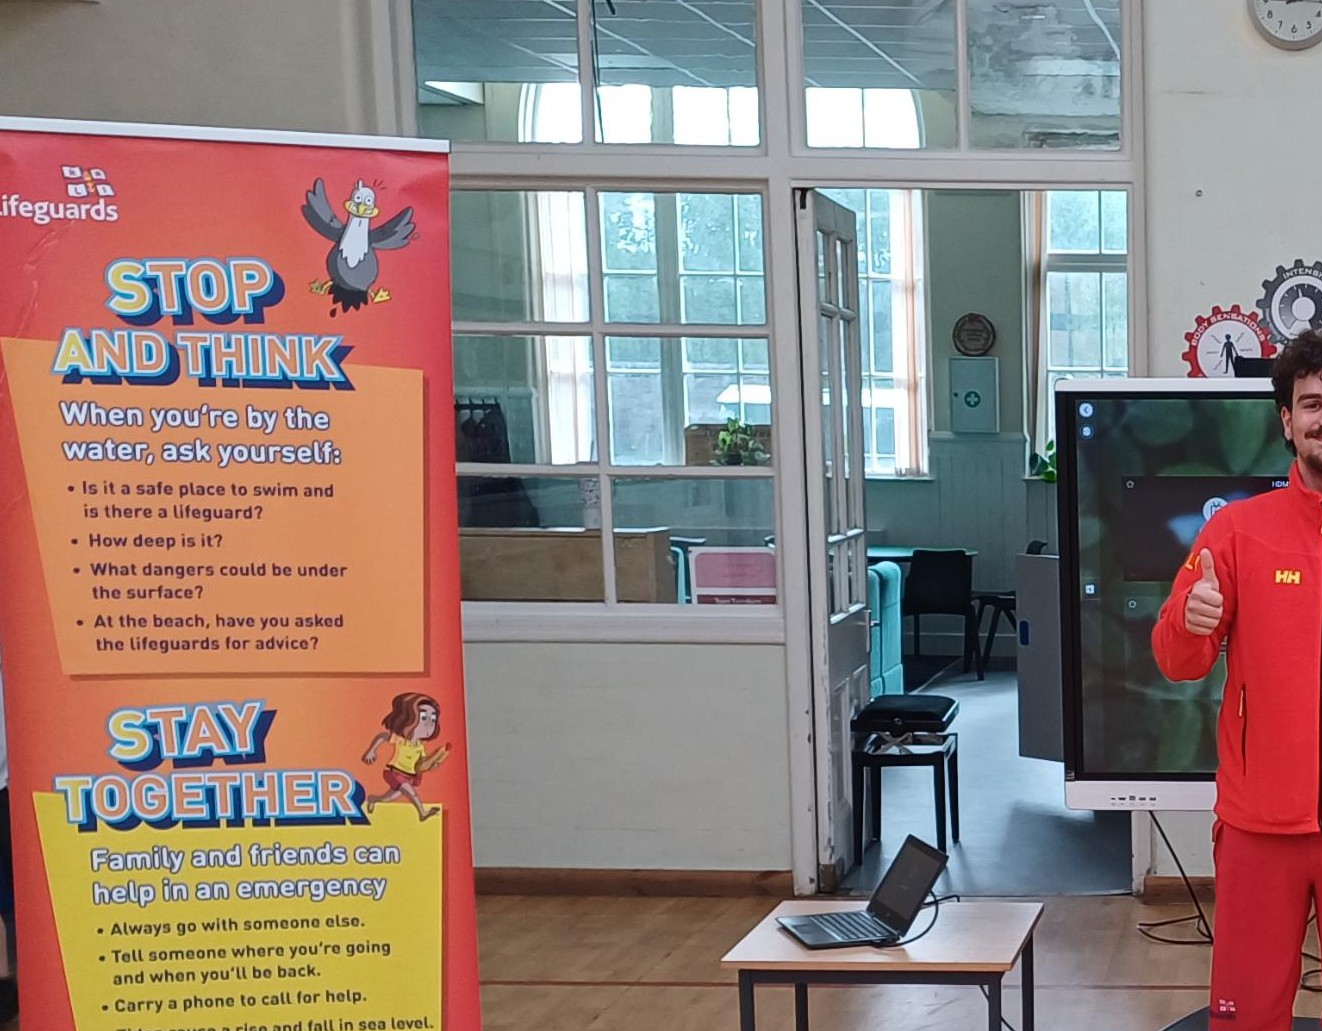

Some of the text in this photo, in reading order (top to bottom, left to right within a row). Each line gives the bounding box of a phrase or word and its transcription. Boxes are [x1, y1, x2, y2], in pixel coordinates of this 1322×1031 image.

[0, 194, 118, 224] ifeguards
[106, 258, 276, 318] STOP
[1191, 313, 1266, 346] BODY SENSATIONS
[51, 329, 347, 382] AND THINK
[59, 401, 329, 434] When you're by the
[62, 438, 340, 467] water, ask yourself:
[82, 480, 333, 498] Is it a safe place to swim and
[83, 503, 262, 522] is there a lifeguard?
[89, 562, 347, 579] What dangers could be under
[1275, 570, 1300, 585] HH
[94, 613, 343, 630] At the beach, have you asked
[95, 636, 318, 653] the lifeguards for advice?
[108, 702, 264, 763] STAY
[54, 773, 363, 824] TOGETHER
[91, 842, 399, 873] Family and friends can
[93, 876, 386, 907] help in an emergency
[110, 915, 364, 937] Always go with someone else.
[114, 989, 366, 1013] Carry a phone to call for help.
